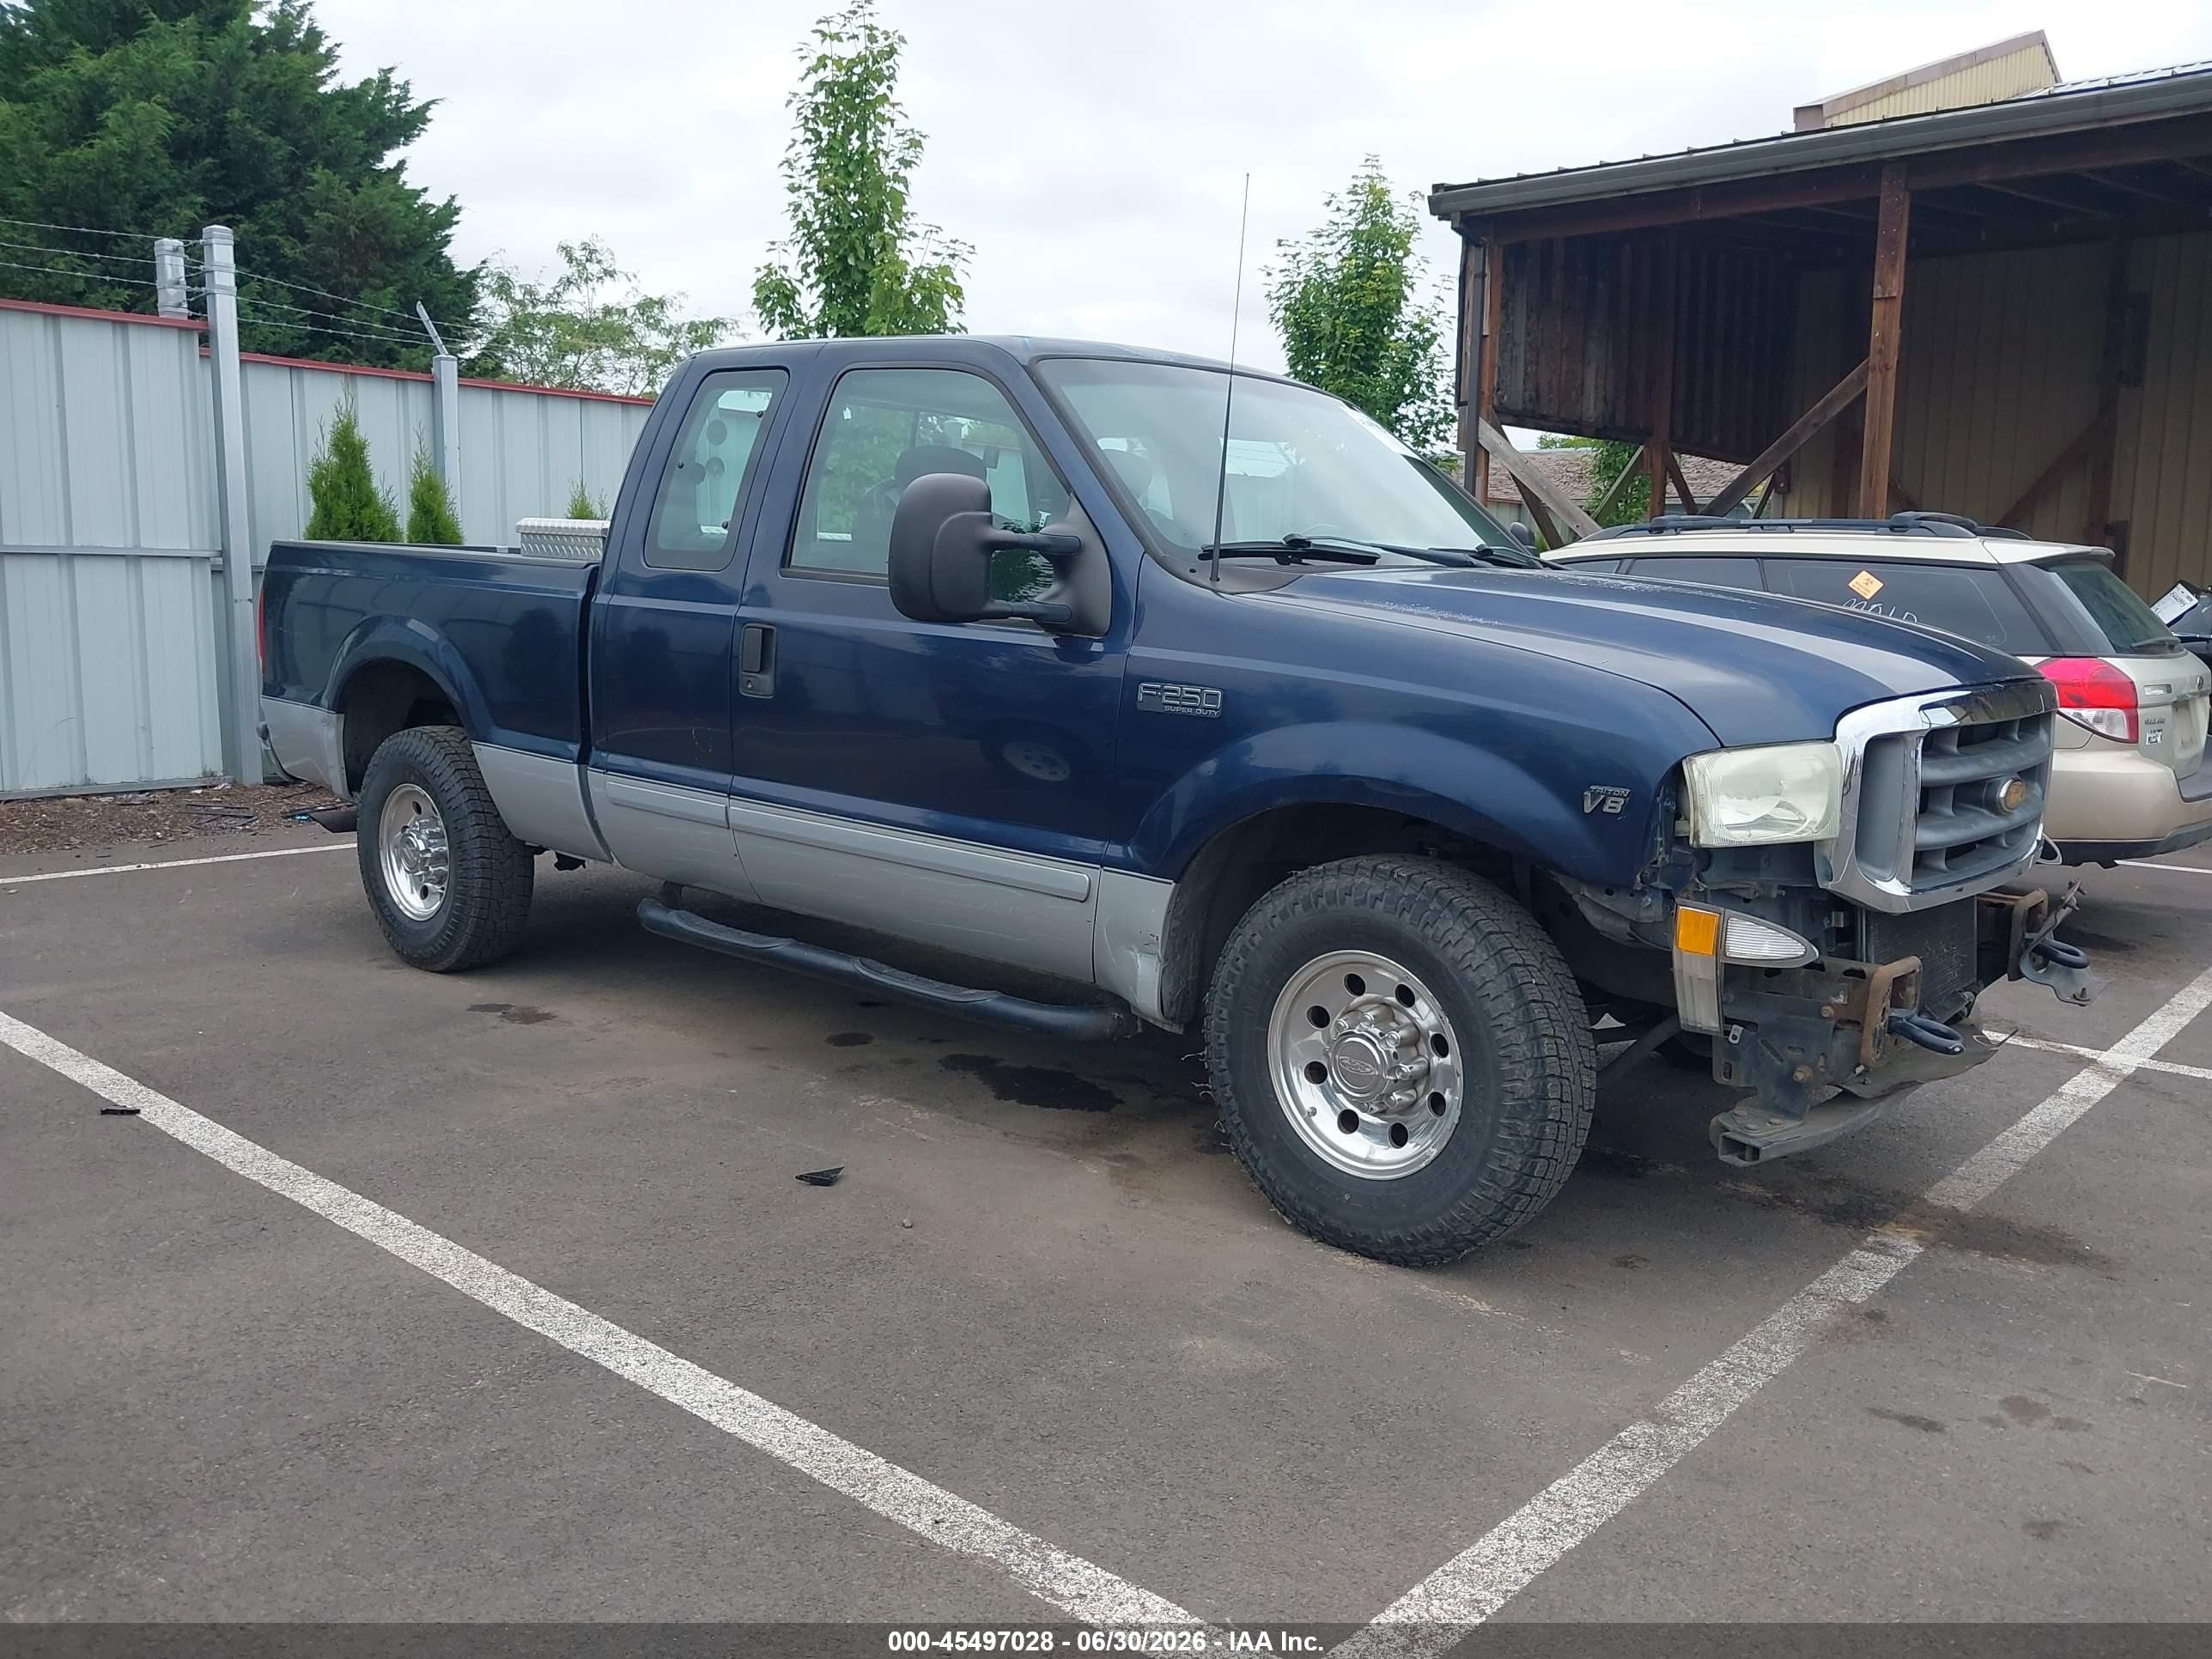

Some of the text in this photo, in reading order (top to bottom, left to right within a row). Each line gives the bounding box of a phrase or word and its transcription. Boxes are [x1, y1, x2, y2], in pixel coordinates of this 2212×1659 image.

[1164, 705, 1220, 717] SUPER DUTY
[1589, 785, 1632, 797] TRITON
[1583, 791, 1625, 814] V8
